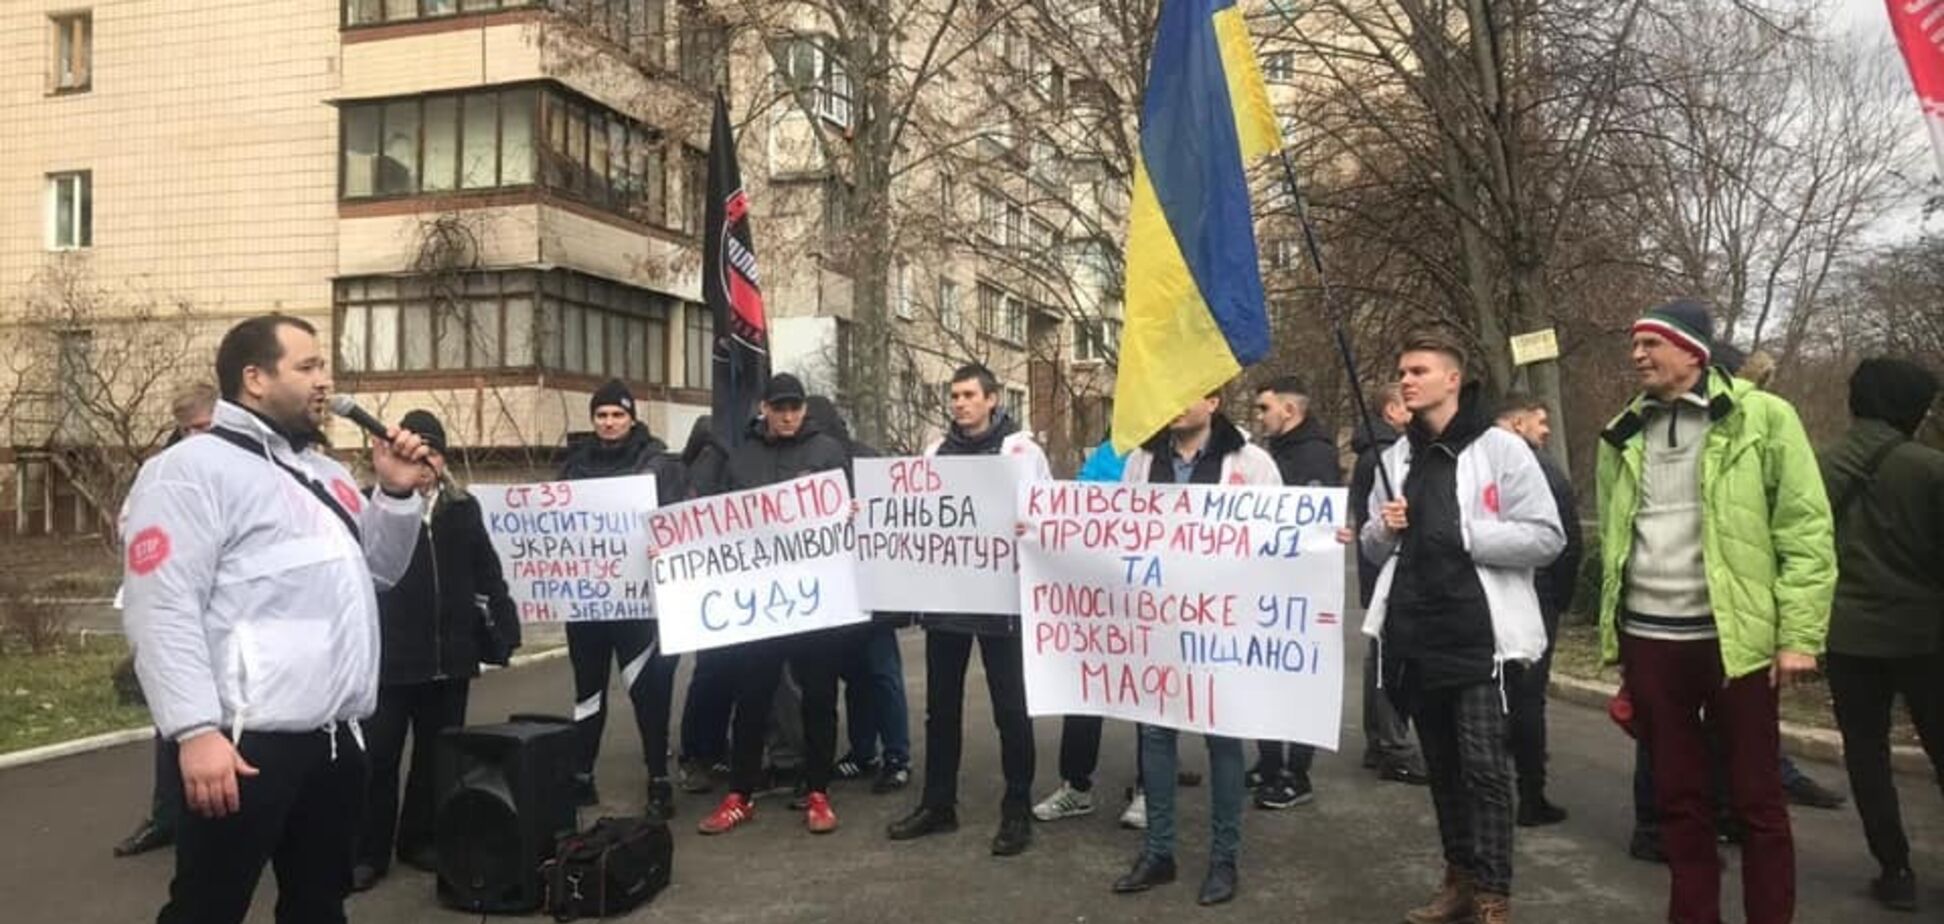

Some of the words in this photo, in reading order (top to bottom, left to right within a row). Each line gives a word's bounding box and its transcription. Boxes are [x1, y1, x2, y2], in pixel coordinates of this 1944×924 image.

[506, 487, 531, 508] СТ
[540, 483, 572, 507] 39
[868, 496, 976, 528] ГАНЬБА
[1203, 491, 1333, 526] МІСЦЕВА
[655, 520, 855, 585] СПРАВЕДЛИВОГО
[1040, 518, 1250, 557] ПРОКУРАТУРА
[1121, 555, 1162, 587] ТА
[532, 579, 611, 600] ПРАВО
[625, 580, 650, 599] НА
[701, 577, 820, 631] СУДУ
[1036, 622, 1152, 656] РОЗКВІТ
